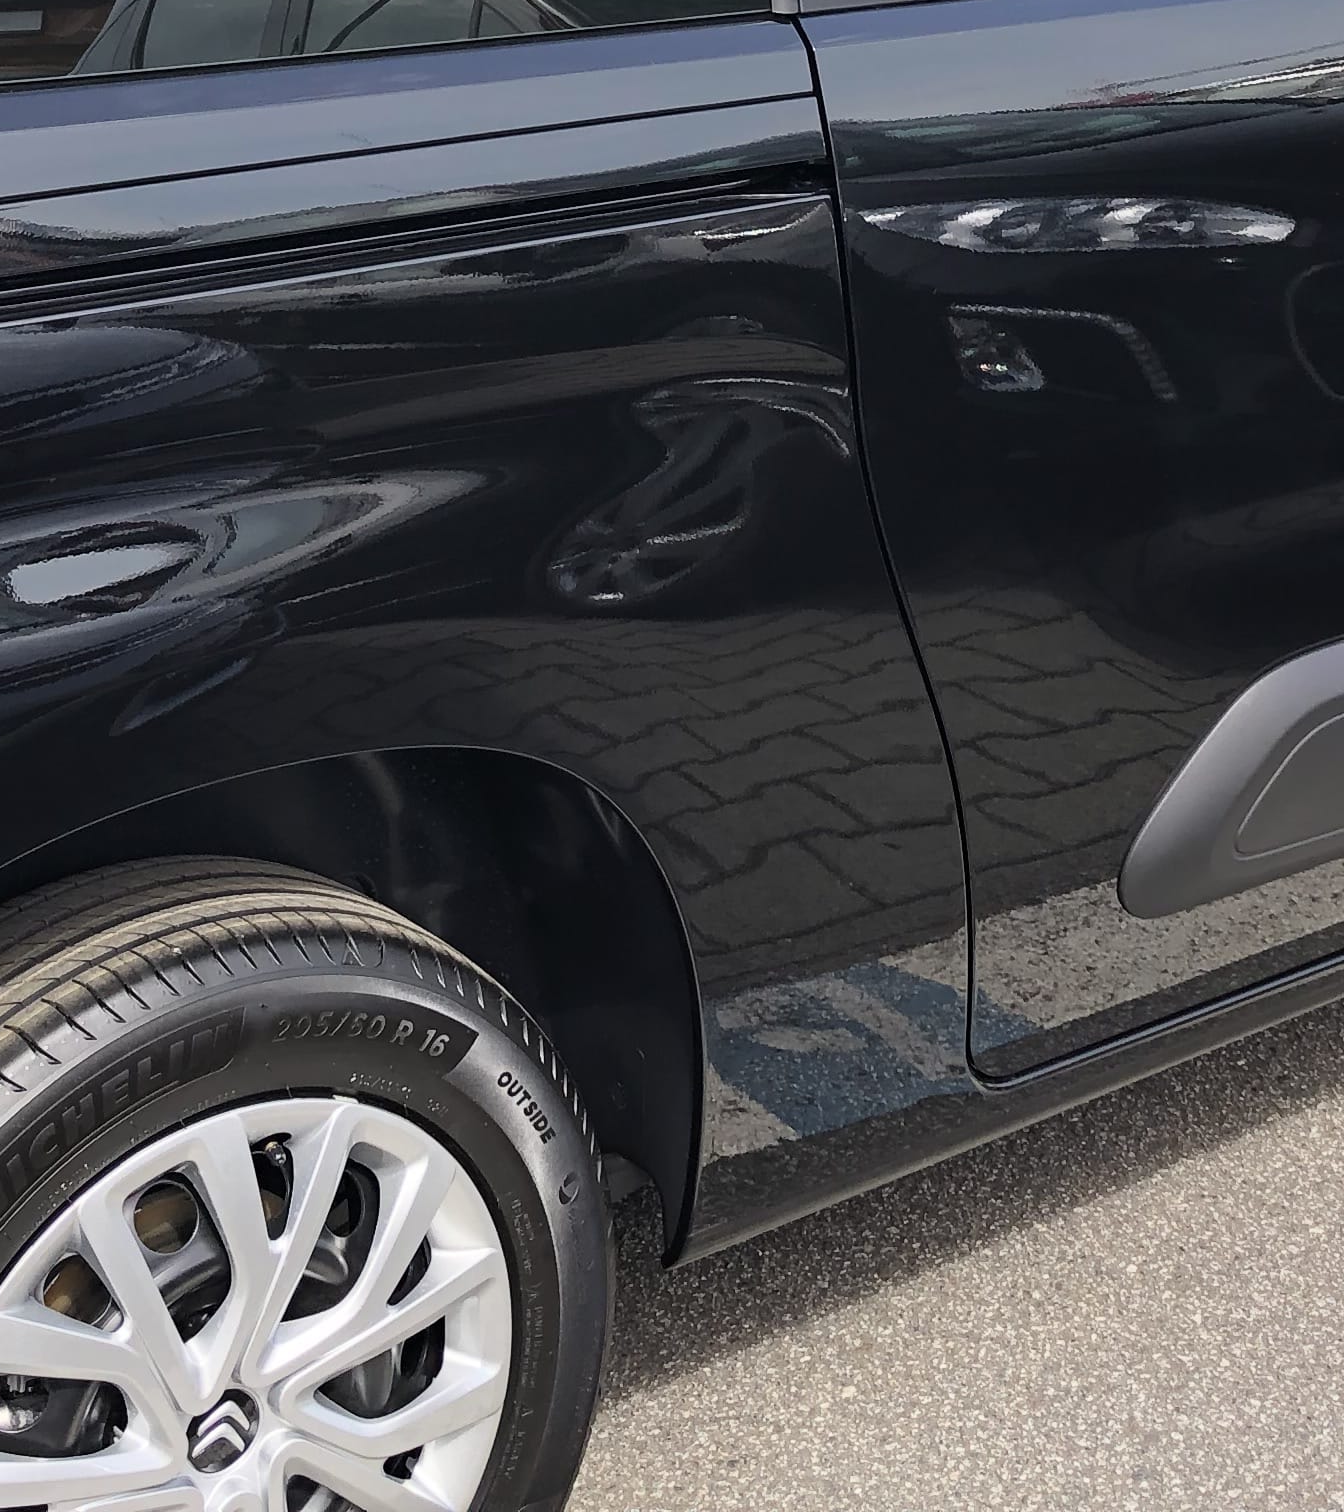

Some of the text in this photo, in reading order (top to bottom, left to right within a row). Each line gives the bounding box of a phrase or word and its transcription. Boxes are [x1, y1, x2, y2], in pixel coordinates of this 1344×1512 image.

[271, 1010, 451, 1057] 205/60 R 16
[496, 1070, 558, 1145] OUTSIDE
